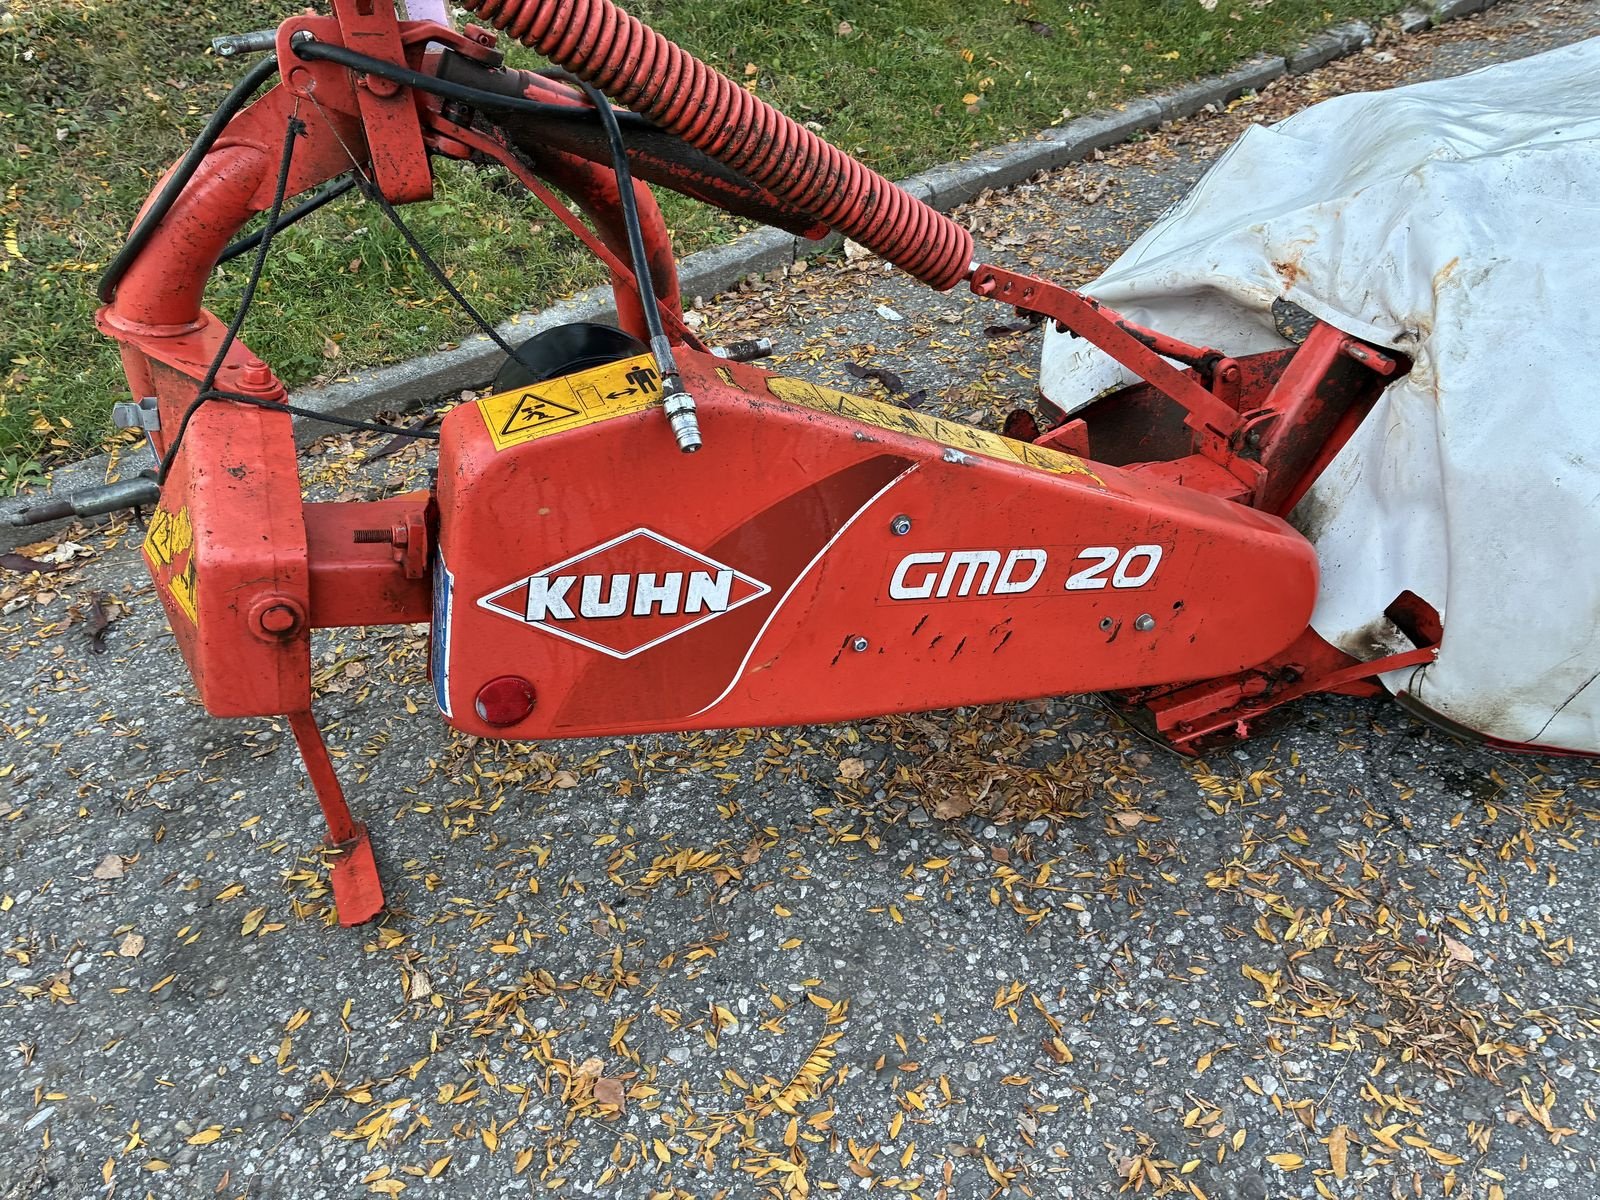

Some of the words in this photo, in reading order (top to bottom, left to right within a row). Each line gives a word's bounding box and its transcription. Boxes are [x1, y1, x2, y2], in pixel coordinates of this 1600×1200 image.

[525, 570, 734, 622] KUHN
[889, 549, 1048, 600] GMD
[1064, 544, 1163, 590] 20
